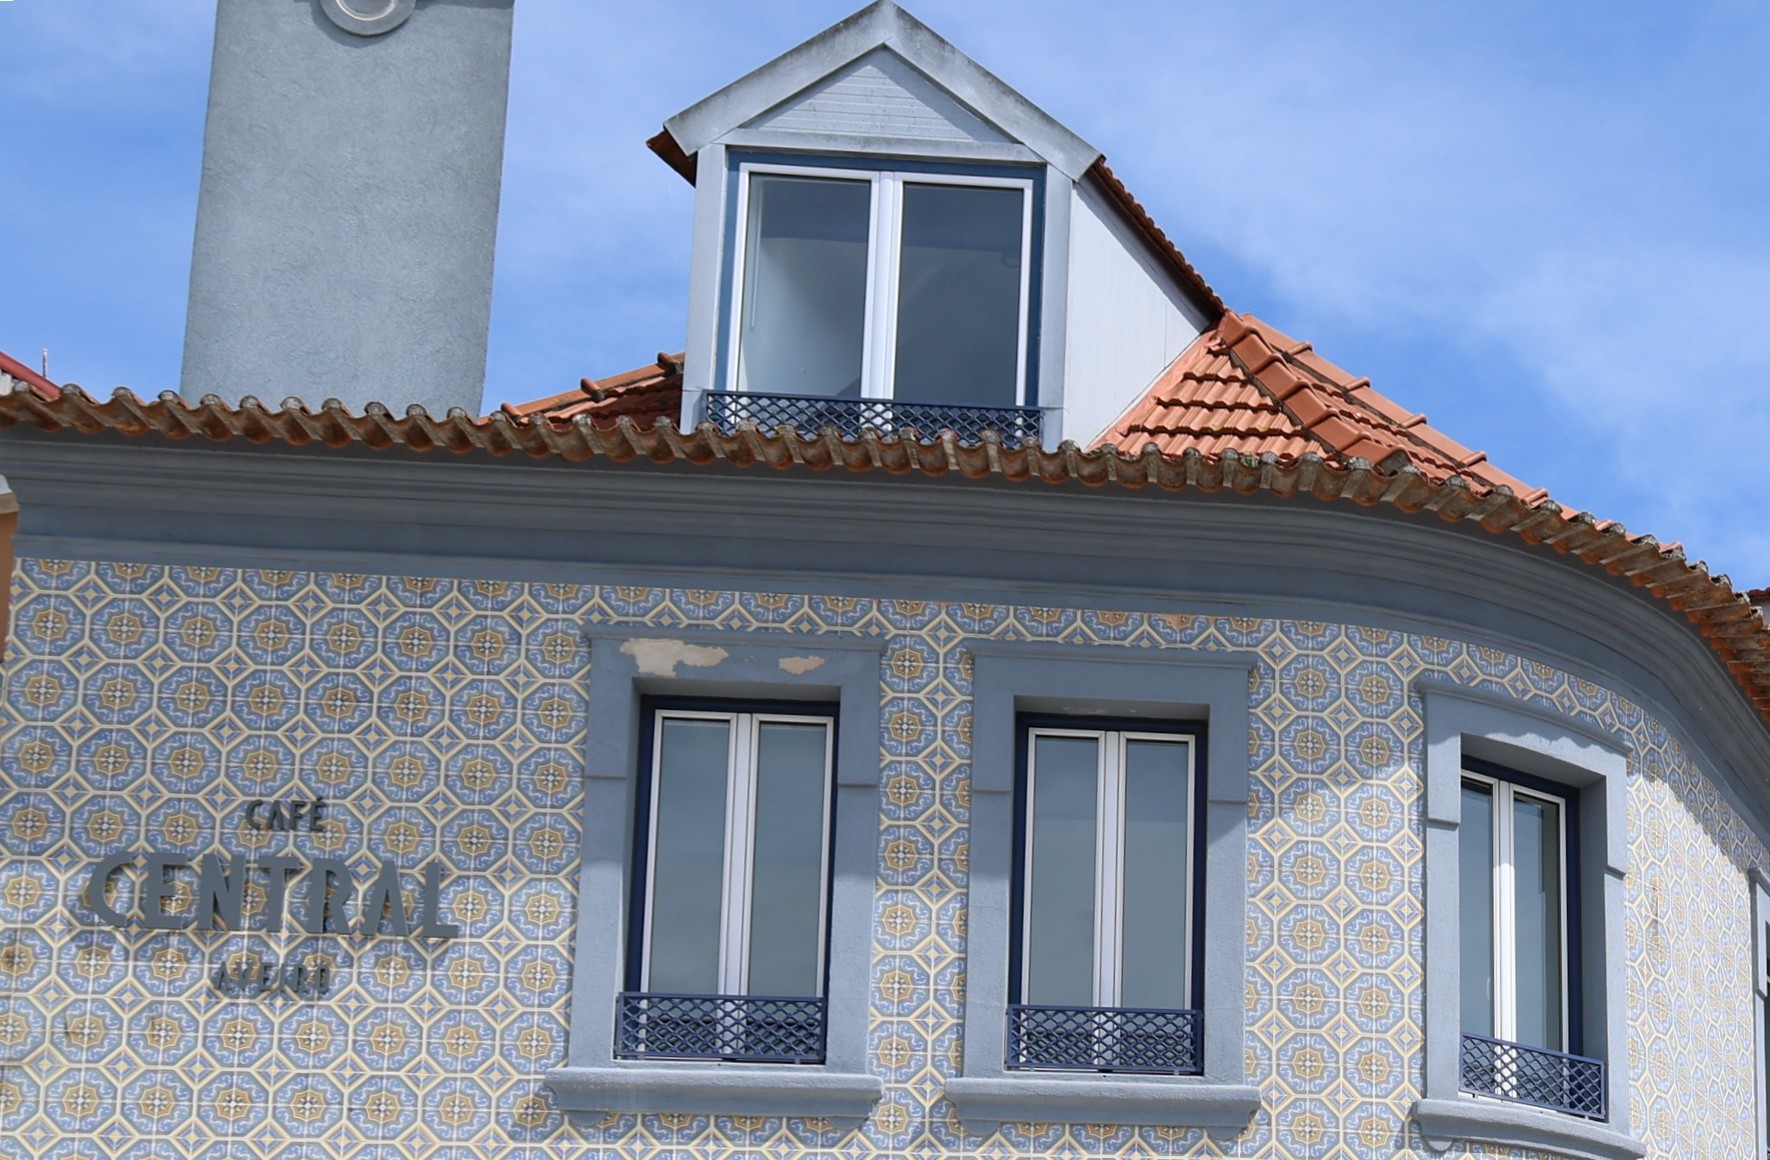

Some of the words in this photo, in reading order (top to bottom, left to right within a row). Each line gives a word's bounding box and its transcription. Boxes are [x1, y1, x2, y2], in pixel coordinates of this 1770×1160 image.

[244, 796, 327, 834] CAFÉ
[88, 850, 460, 939] CENTRAL
[213, 960, 331, 995] AVEIRO
